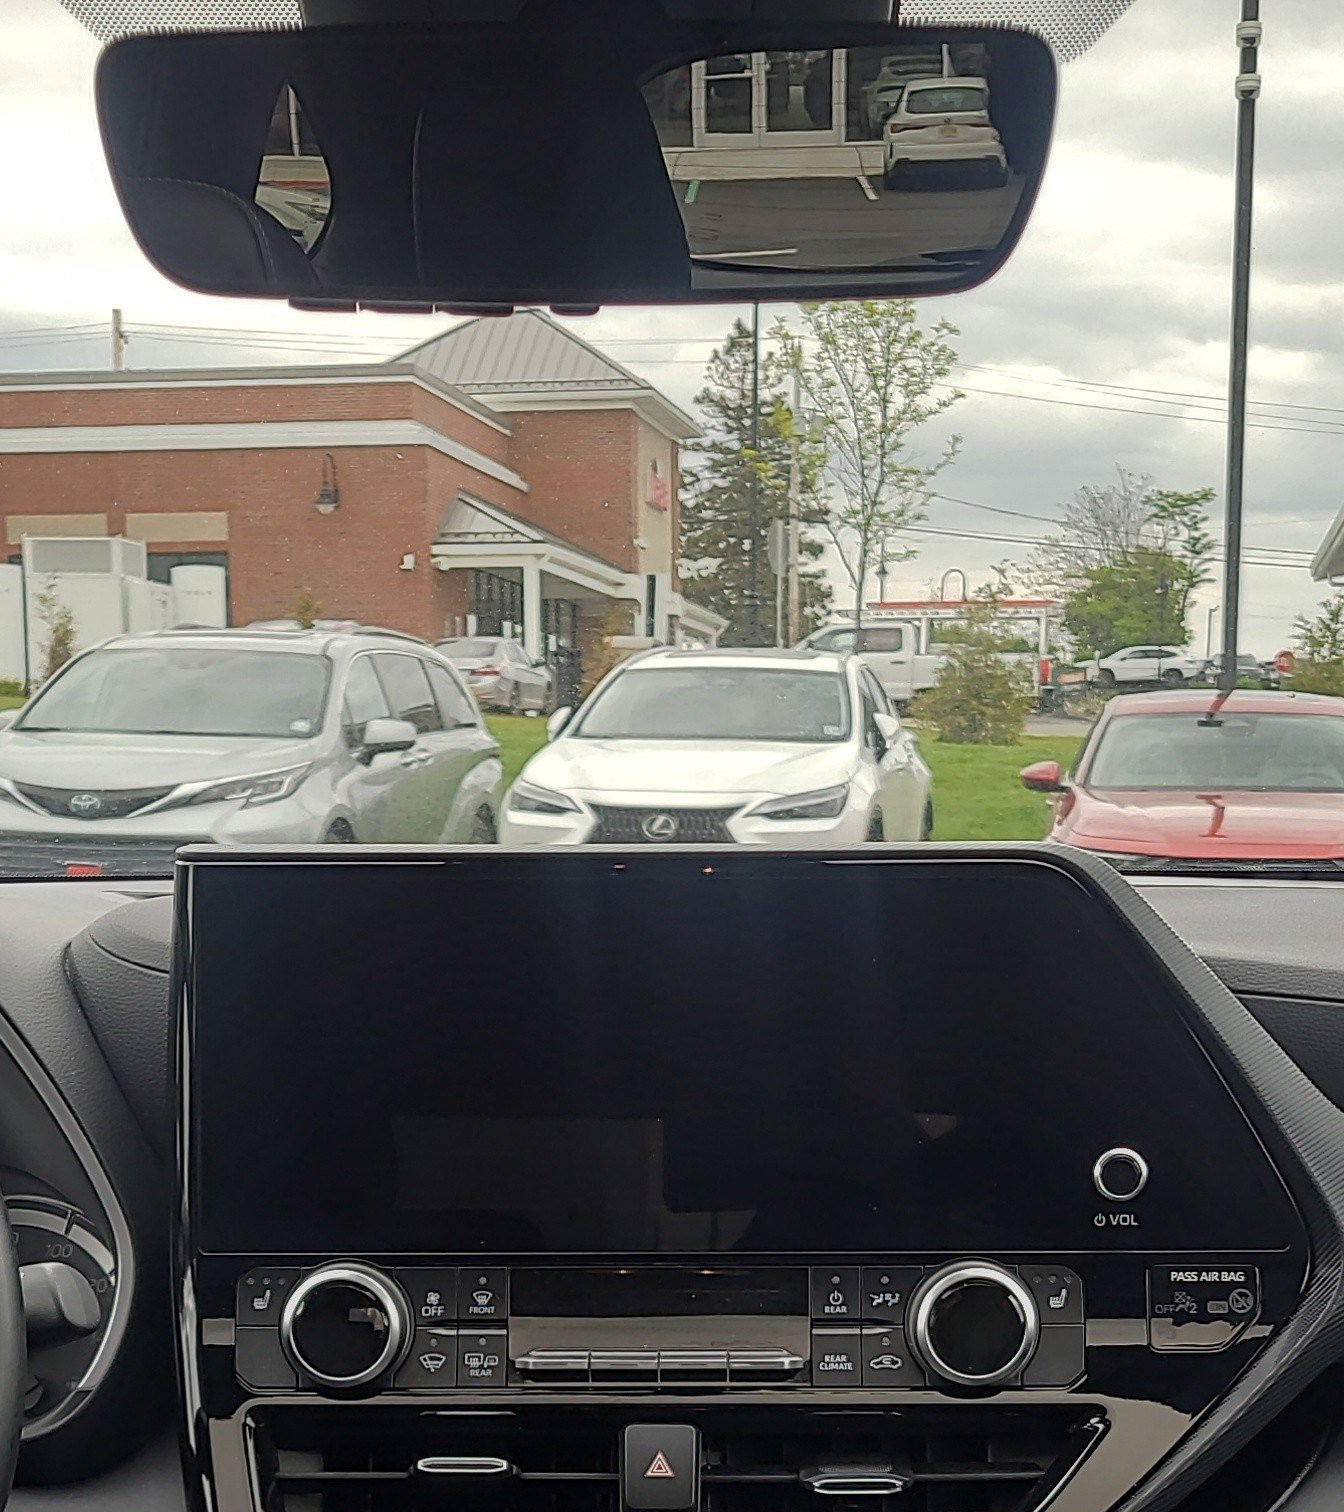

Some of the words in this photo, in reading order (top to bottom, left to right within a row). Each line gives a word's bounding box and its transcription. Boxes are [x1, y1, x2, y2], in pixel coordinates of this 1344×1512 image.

[1109, 1213, 1139, 1226] VOL
[1170, 1271, 1198, 1282] PASS
[1199, 1271, 1219, 1282] AIR
[1221, 1271, 1246, 1282] BAG
[421, 1306, 445, 1317] OFF
[468, 1306, 496, 1314] FRONT
[824, 1305, 848, 1314] REAR
[1155, 1304, 1175, 1314] OFF
[824, 1354, 848, 1362] REAR
[818, 1362, 853, 1371] CLIMATE
[469, 1368, 493, 1377] REAR
